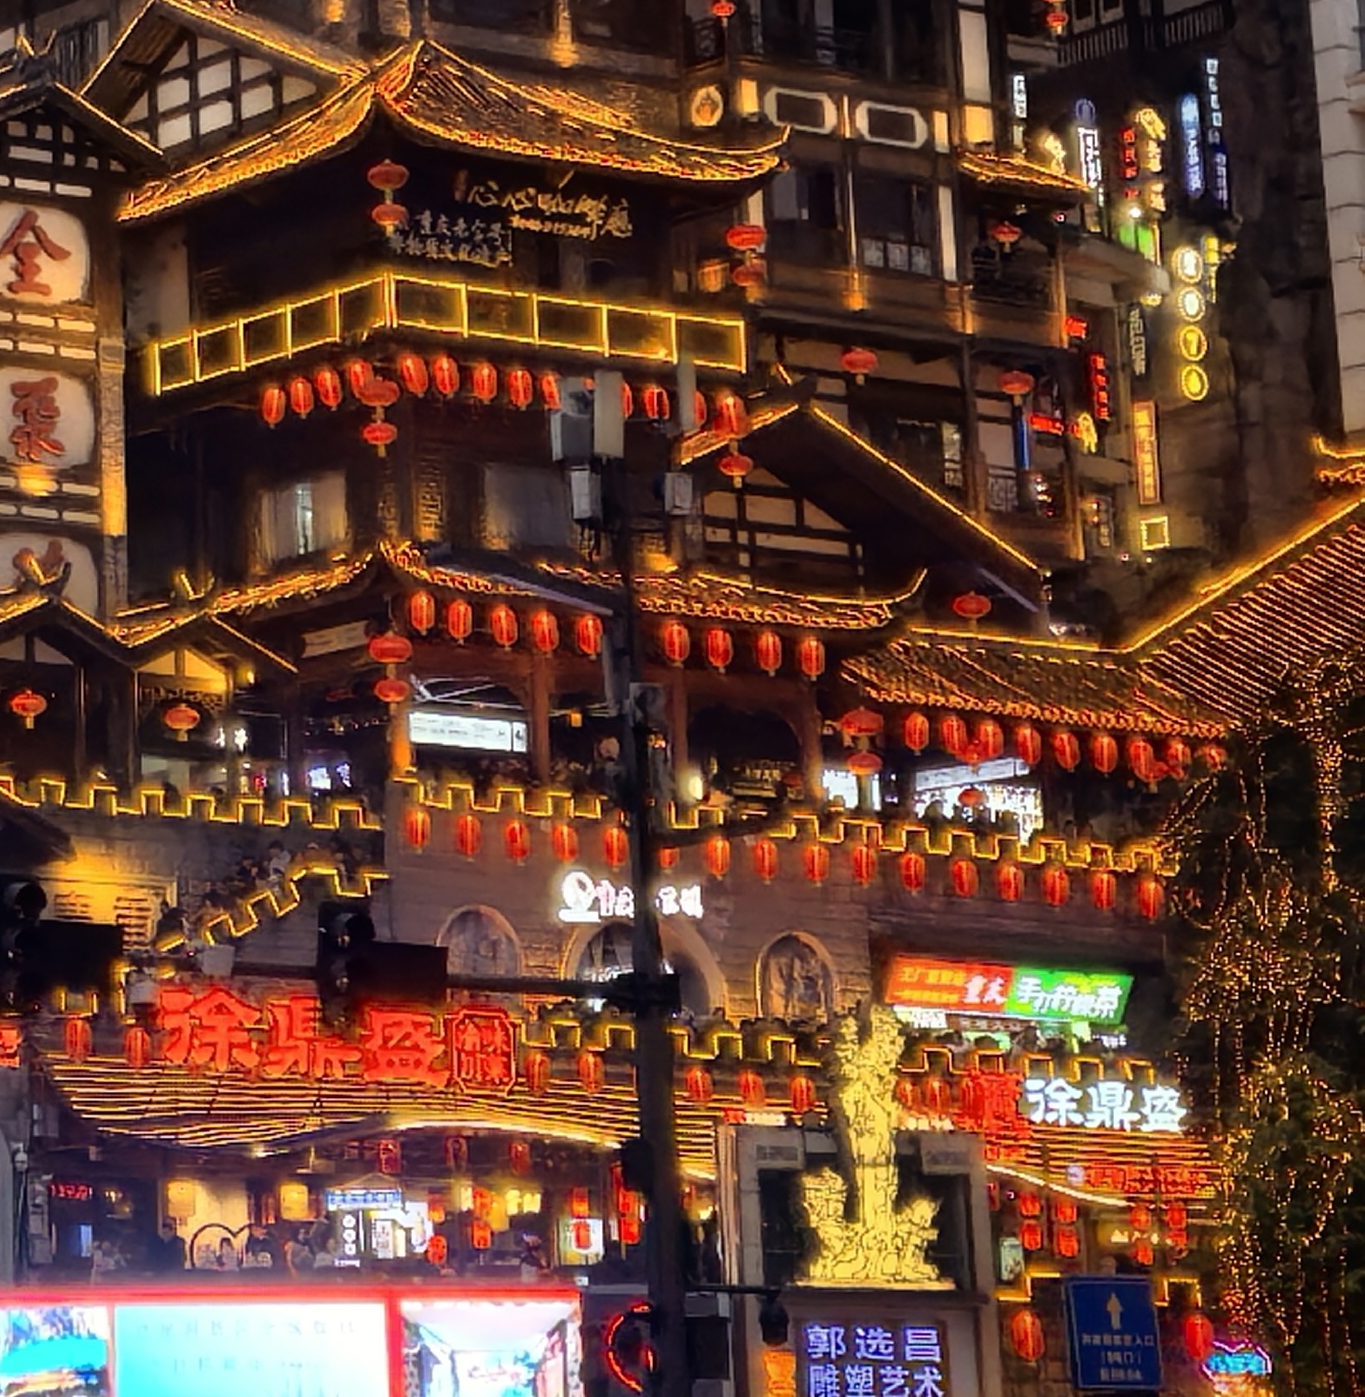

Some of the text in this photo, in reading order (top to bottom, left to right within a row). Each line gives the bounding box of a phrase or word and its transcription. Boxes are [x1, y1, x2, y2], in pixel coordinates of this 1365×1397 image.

[1024, 1077, 1188, 1133] 徐鼎盛
[806, 1323, 942, 1363] 郭选昌
[809, 1363, 946, 1397] 雕塑艺术
